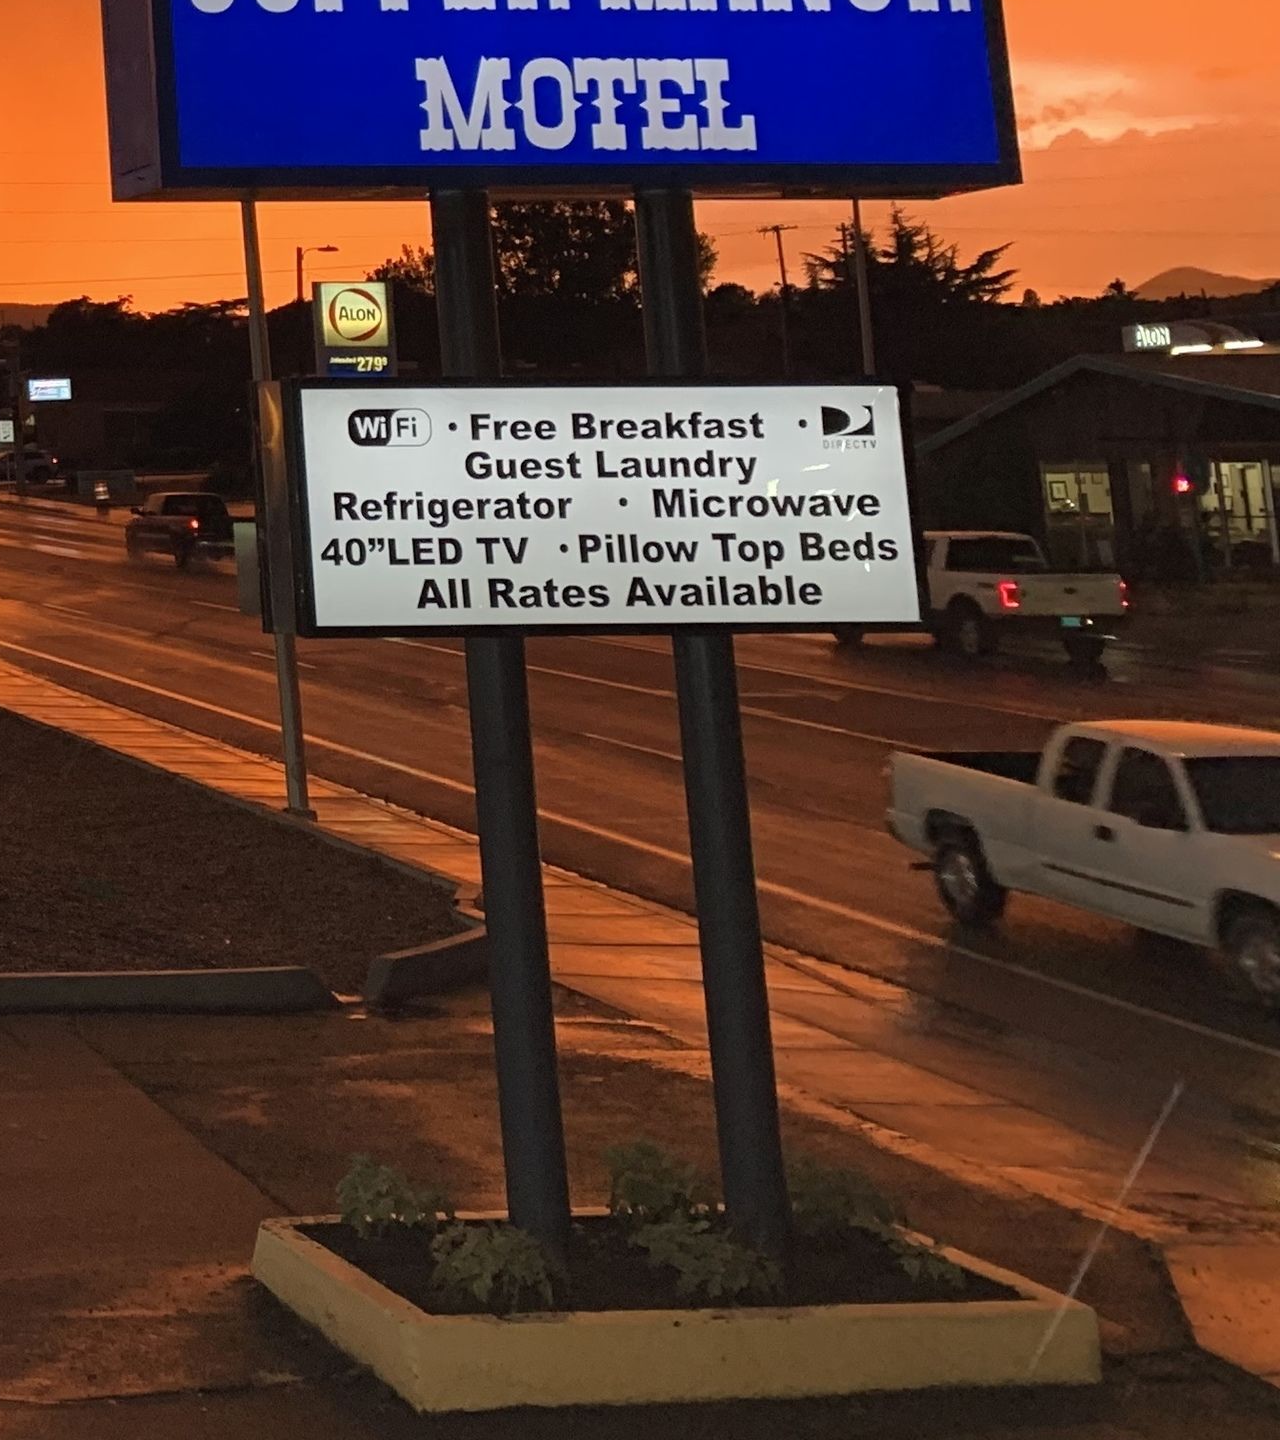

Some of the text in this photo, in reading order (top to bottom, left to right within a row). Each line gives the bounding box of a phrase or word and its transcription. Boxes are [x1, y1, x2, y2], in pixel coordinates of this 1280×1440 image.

[415, 55, 758, 151] MOTEL
[339, 306, 376, 321] ALON
[470, 413, 557, 440] Free
[571, 412, 765, 440] Breakfast
[823, 440, 877, 449] DIRECTV
[465, 449, 757, 485] Guest Laundry
[333, 488, 881, 528] Refrigerator Microwave
[476, 537, 529, 564] TV
[578, 533, 699, 564] Pillow
[711, 533, 785, 570] Top
[799, 531, 899, 561] Beds
[417, 575, 823, 609] All Rates Available
